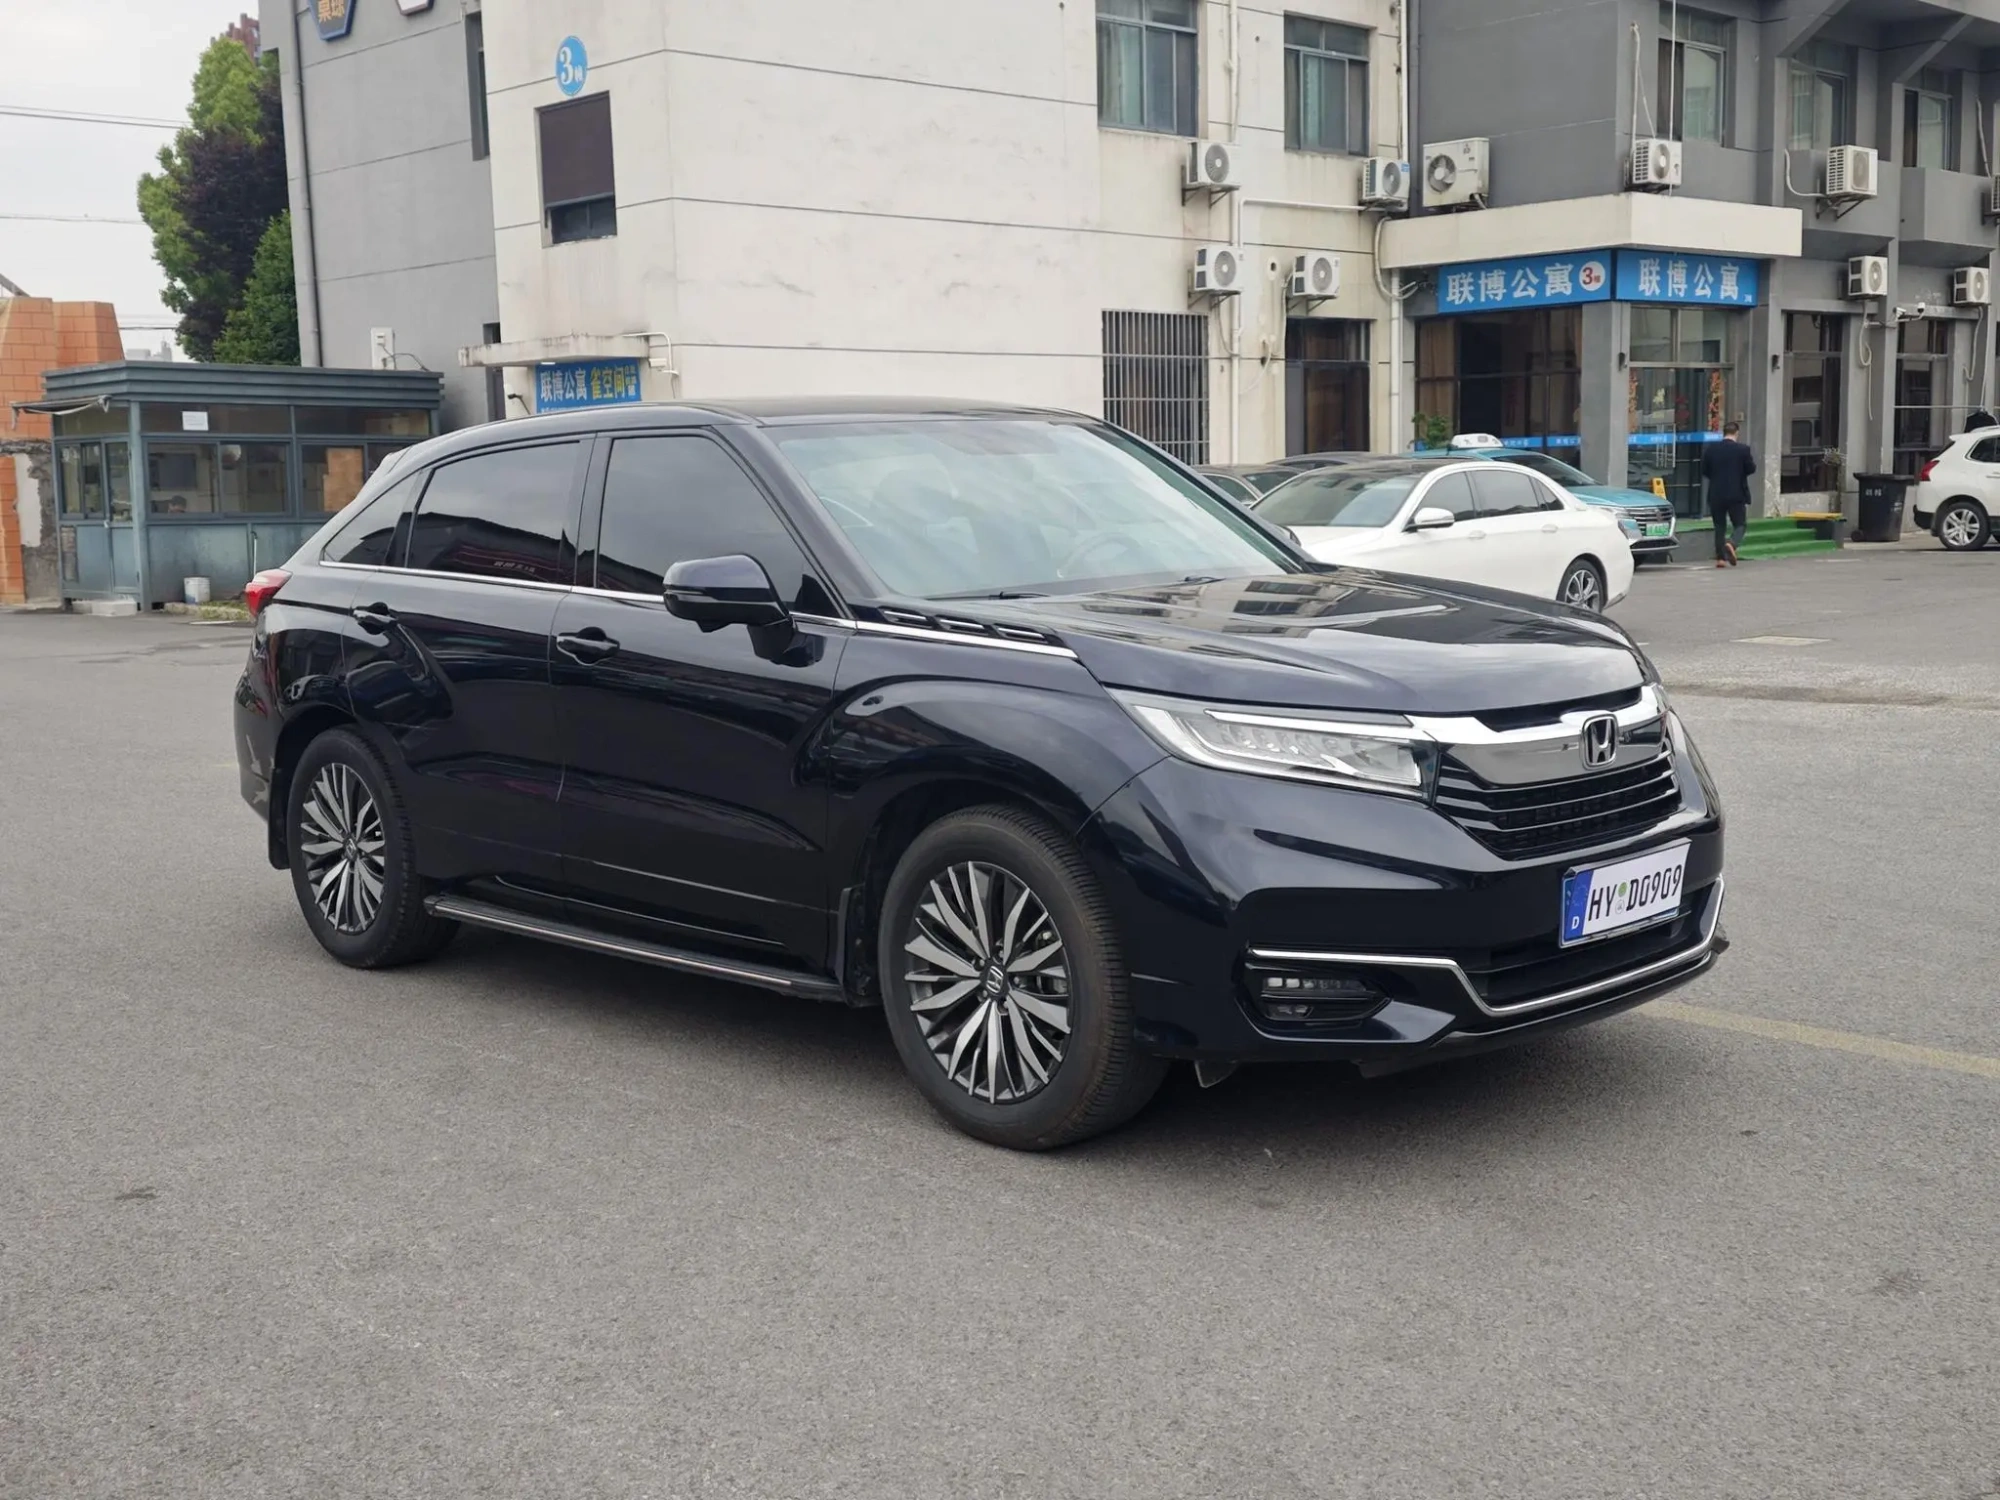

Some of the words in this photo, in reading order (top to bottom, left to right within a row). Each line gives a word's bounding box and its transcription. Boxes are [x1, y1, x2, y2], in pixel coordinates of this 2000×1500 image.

[1446, 263, 1574, 305] 联博公寓
[1638, 257, 1740, 302] 联博公寓
[540, 367, 588, 401] 联博公寓
[1588, 884, 1618, 922] HY
[1571, 916, 1580, 930] D
